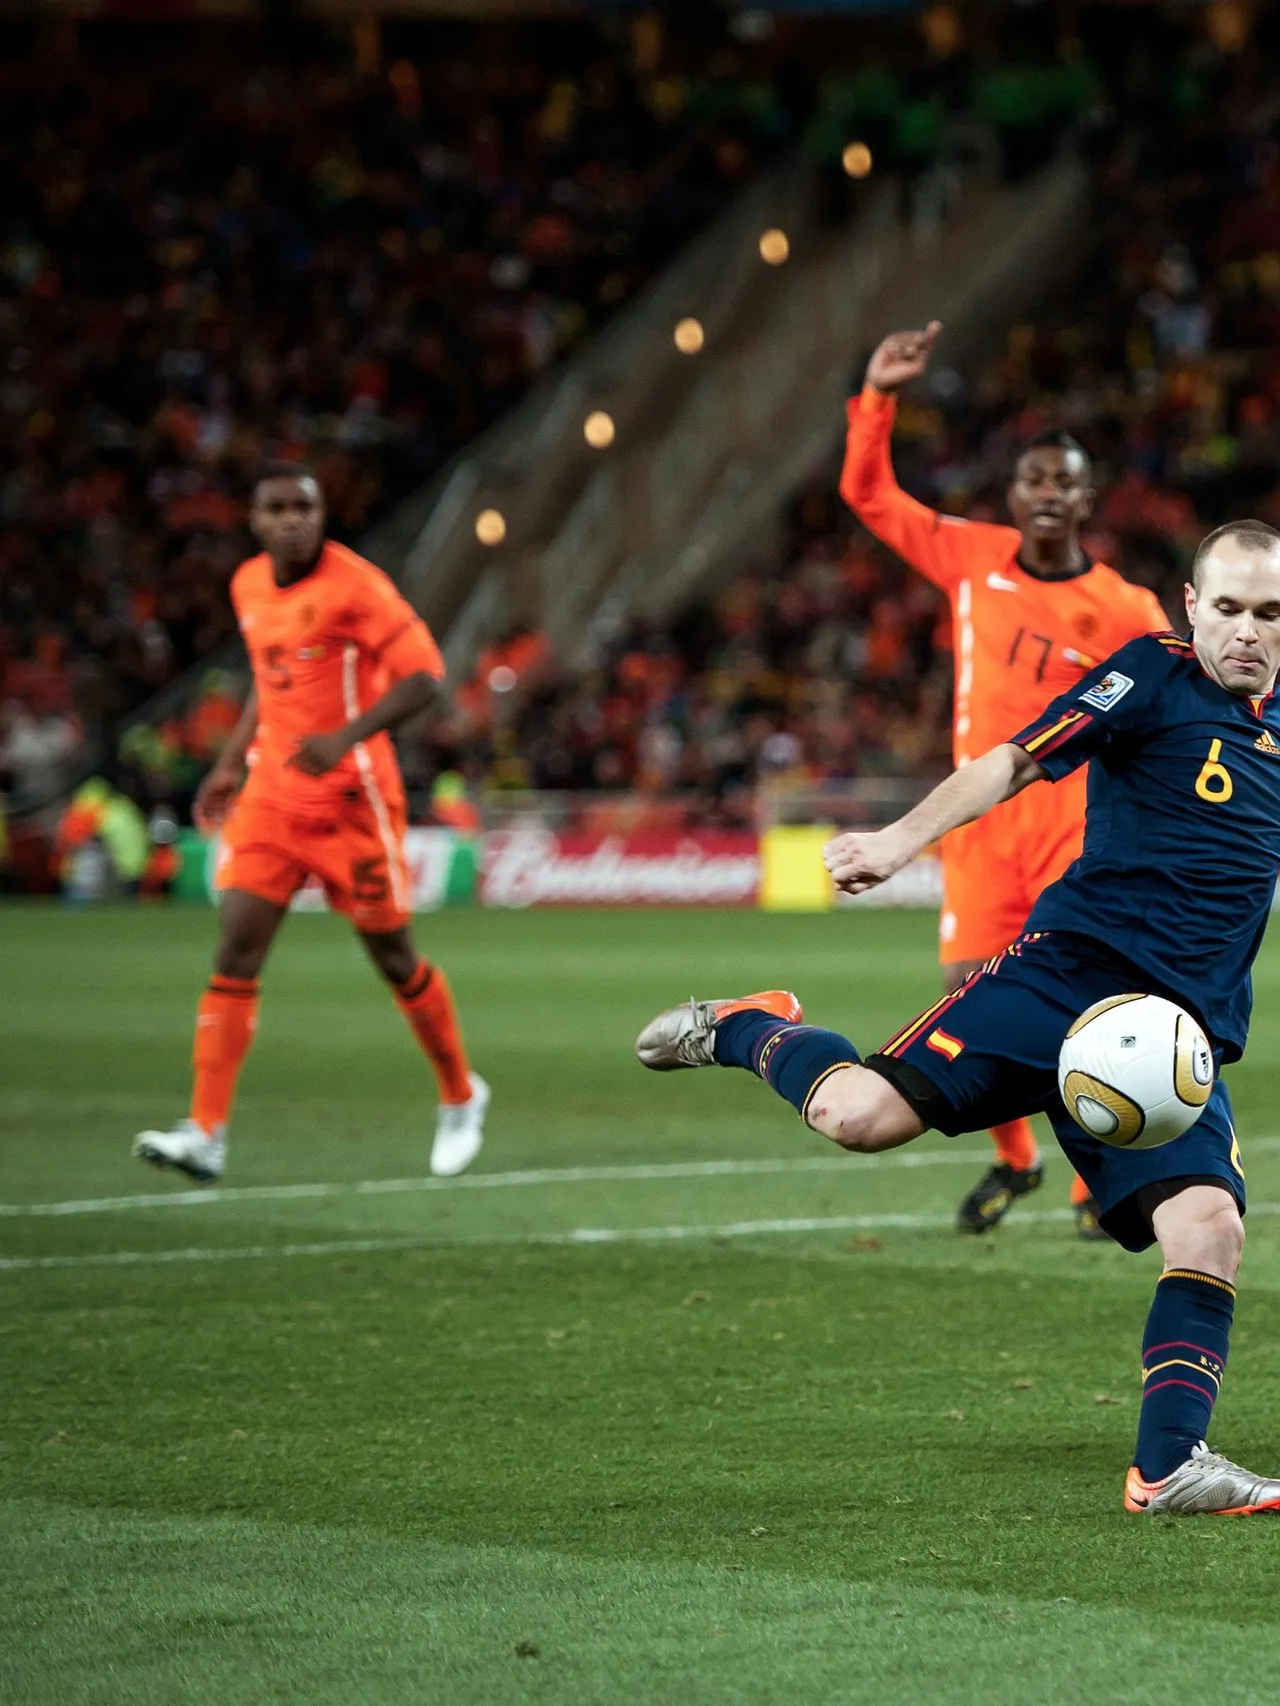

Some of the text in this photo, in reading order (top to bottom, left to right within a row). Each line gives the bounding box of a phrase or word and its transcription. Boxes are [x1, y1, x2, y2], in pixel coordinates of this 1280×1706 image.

[1007, 626, 1053, 684] 17
[1194, 737, 1233, 803] 6
[1253, 741, 1280, 756] adidas
